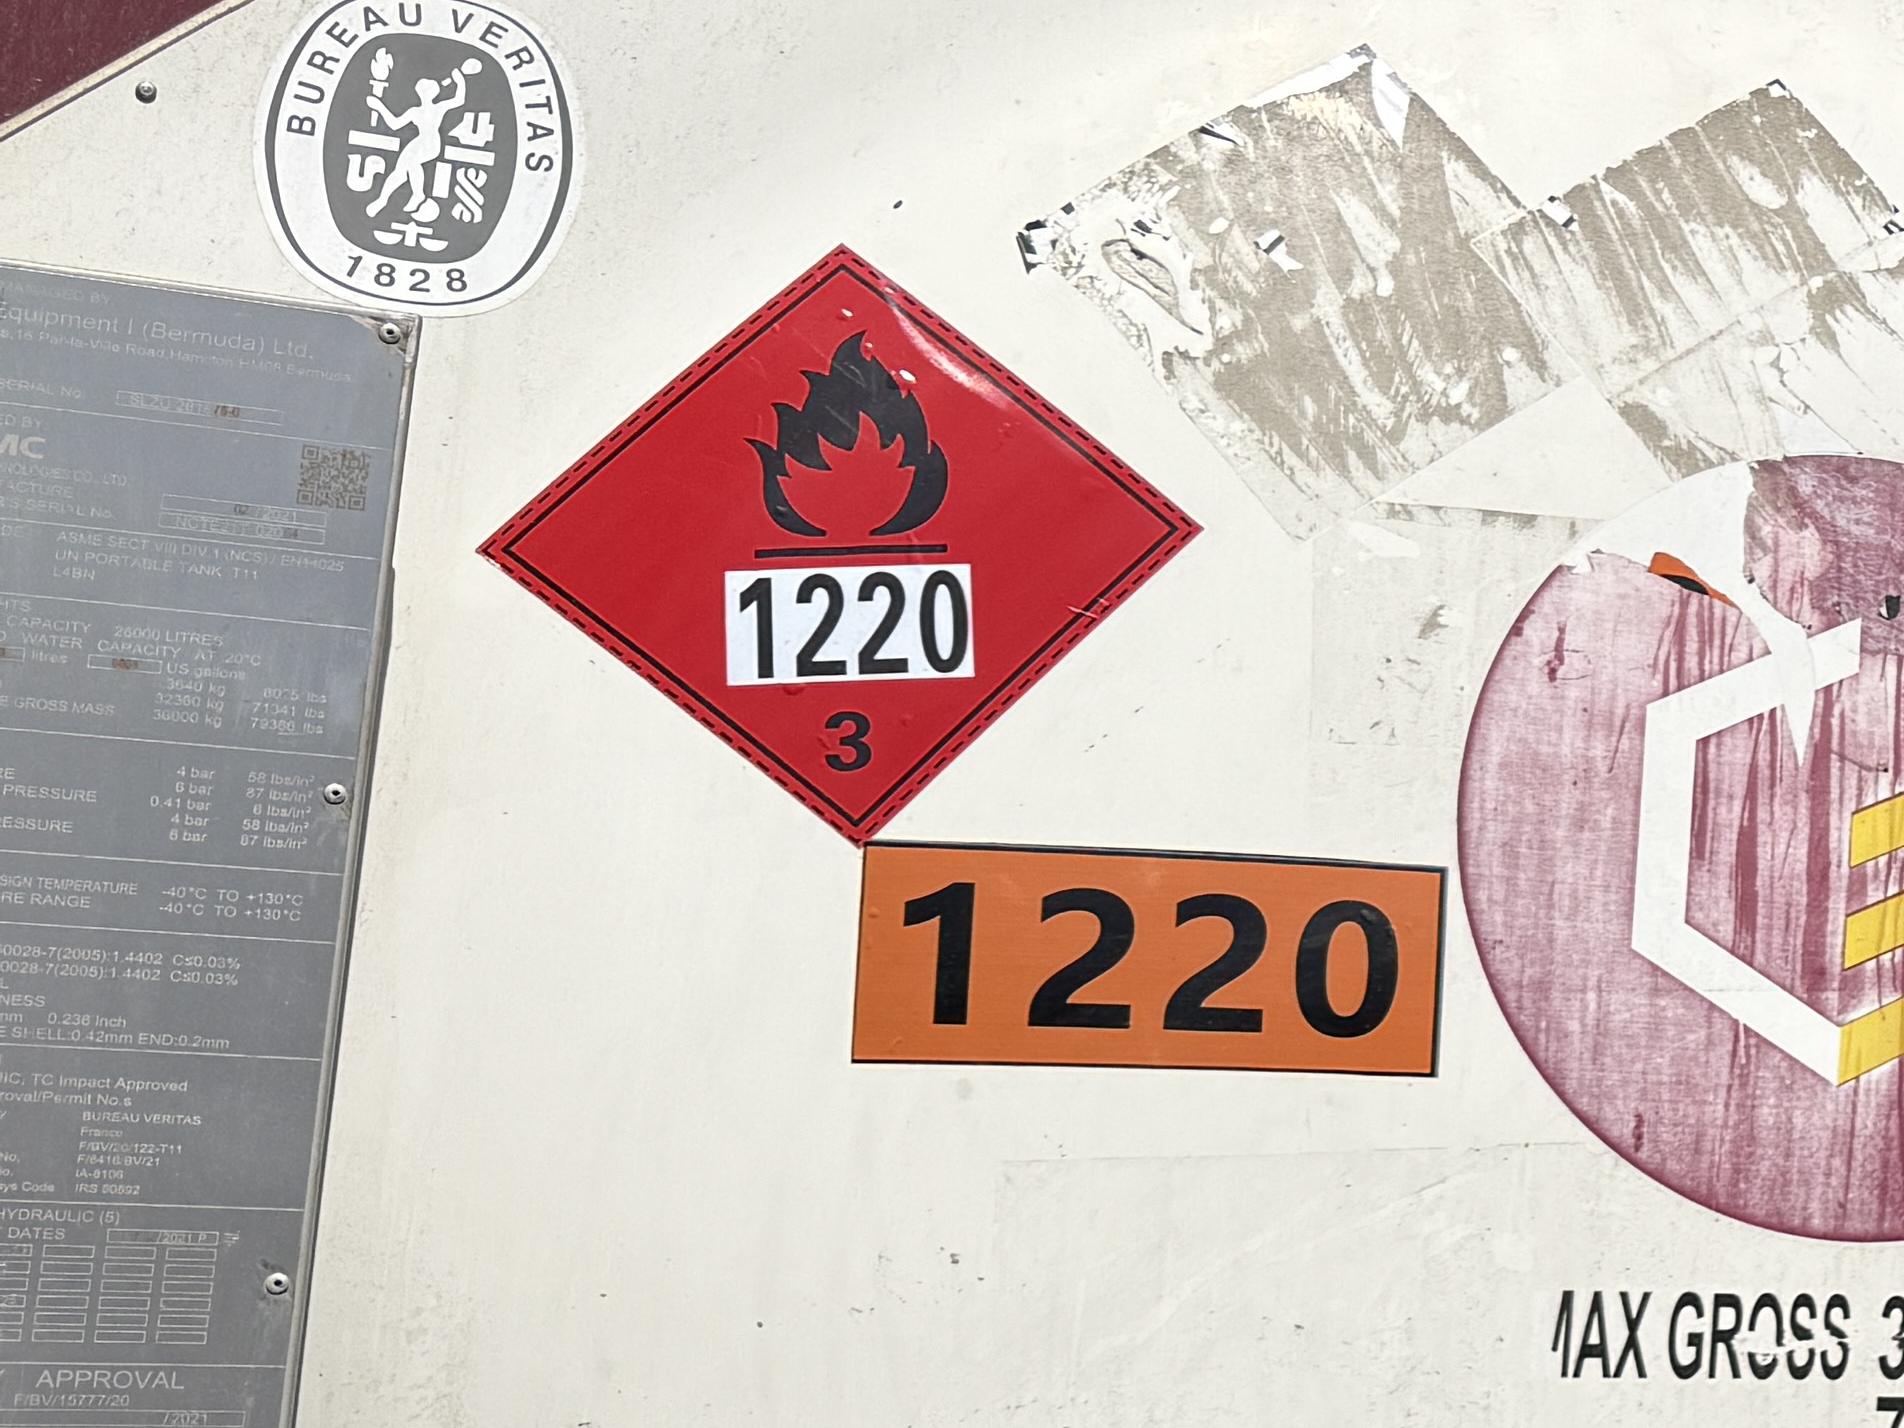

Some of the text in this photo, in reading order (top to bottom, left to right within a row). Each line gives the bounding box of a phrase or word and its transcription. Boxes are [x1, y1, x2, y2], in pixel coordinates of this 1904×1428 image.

[287, 3, 555, 172] BUREAU VERITAS
[347, 255, 468, 292] 1828
[142, 321, 265, 356] (Bermuda)
[273, 338, 314, 359] Ltd.
[107, 536, 151, 550] SECT
[84, 552, 173, 572] PORTABLE
[177, 562, 222, 578] TANK
[6, 614, 224, 647] CAPACITY LITRES
[737, 570, 970, 680] 1220
[22, 632, 217, 660] WATER CAPACITY AT
[31, 650, 68, 664] litres
[167, 663, 190, 674] US
[208, 682, 226, 697] kg
[14, 698, 71, 712] GROSS
[72, 703, 116, 716] MASS
[204, 714, 222, 728] kg
[206, 697, 326, 719] kg lbs
[823, 710, 873, 773] 3
[177, 766, 186, 778] 4
[191, 767, 216, 780] bar
[3, 784, 97, 803] PRESSURE
[190, 783, 214, 796] bar
[150, 796, 182, 809] 0.41
[187, 799, 212, 811] bar
[171, 814, 260, 831] 4 bar 58
[184, 830, 258, 847] bar 87
[36, 877, 138, 896] TEMPERATURE
[218, 889, 239, 902] TO
[246, 892, 304, 906] +130°C
[30, 893, 302, 922] RANGE -40°C TO +130°C
[901, 881, 1399, 1038] 1220
[31, 1074, 189, 1093] TC Impact Approved
[96, 1094, 132, 1107] No.s
[82, 1111, 202, 1126] BUREAU VERITAS
[100, 1211, 120, 1226] (5)
[7, 1227, 65, 1240] DATES
[1667, 1291, 1851, 1380] GROSS
[35, 1370, 185, 1389] APPROVAL
